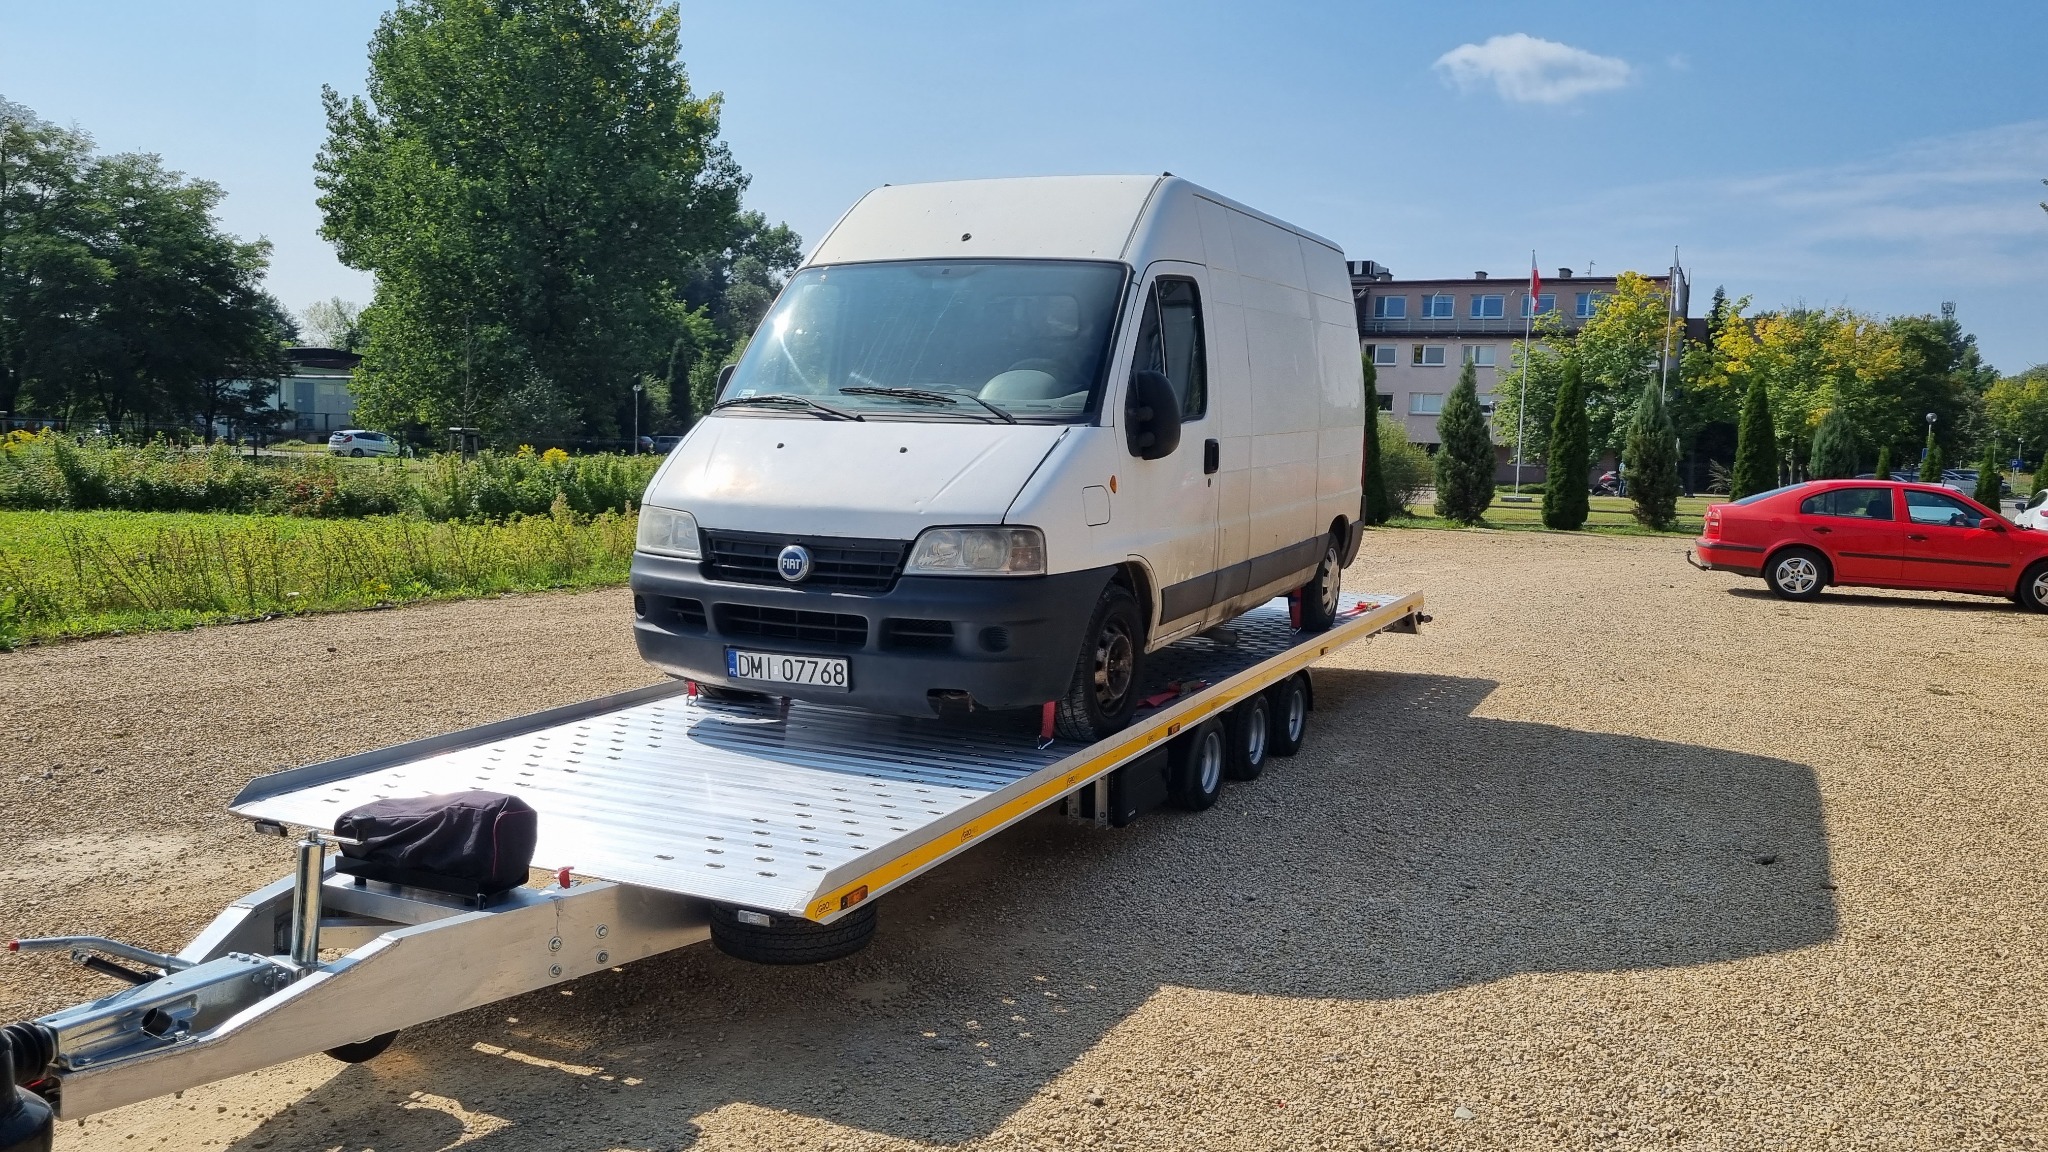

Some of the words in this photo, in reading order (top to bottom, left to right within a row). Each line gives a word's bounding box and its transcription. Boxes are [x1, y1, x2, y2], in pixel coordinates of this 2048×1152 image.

[782, 558, 802, 570] FIAT
[728, 667, 737, 675] PL
[738, 654, 771, 680] DMI
[782, 658, 845, 686] 07768
